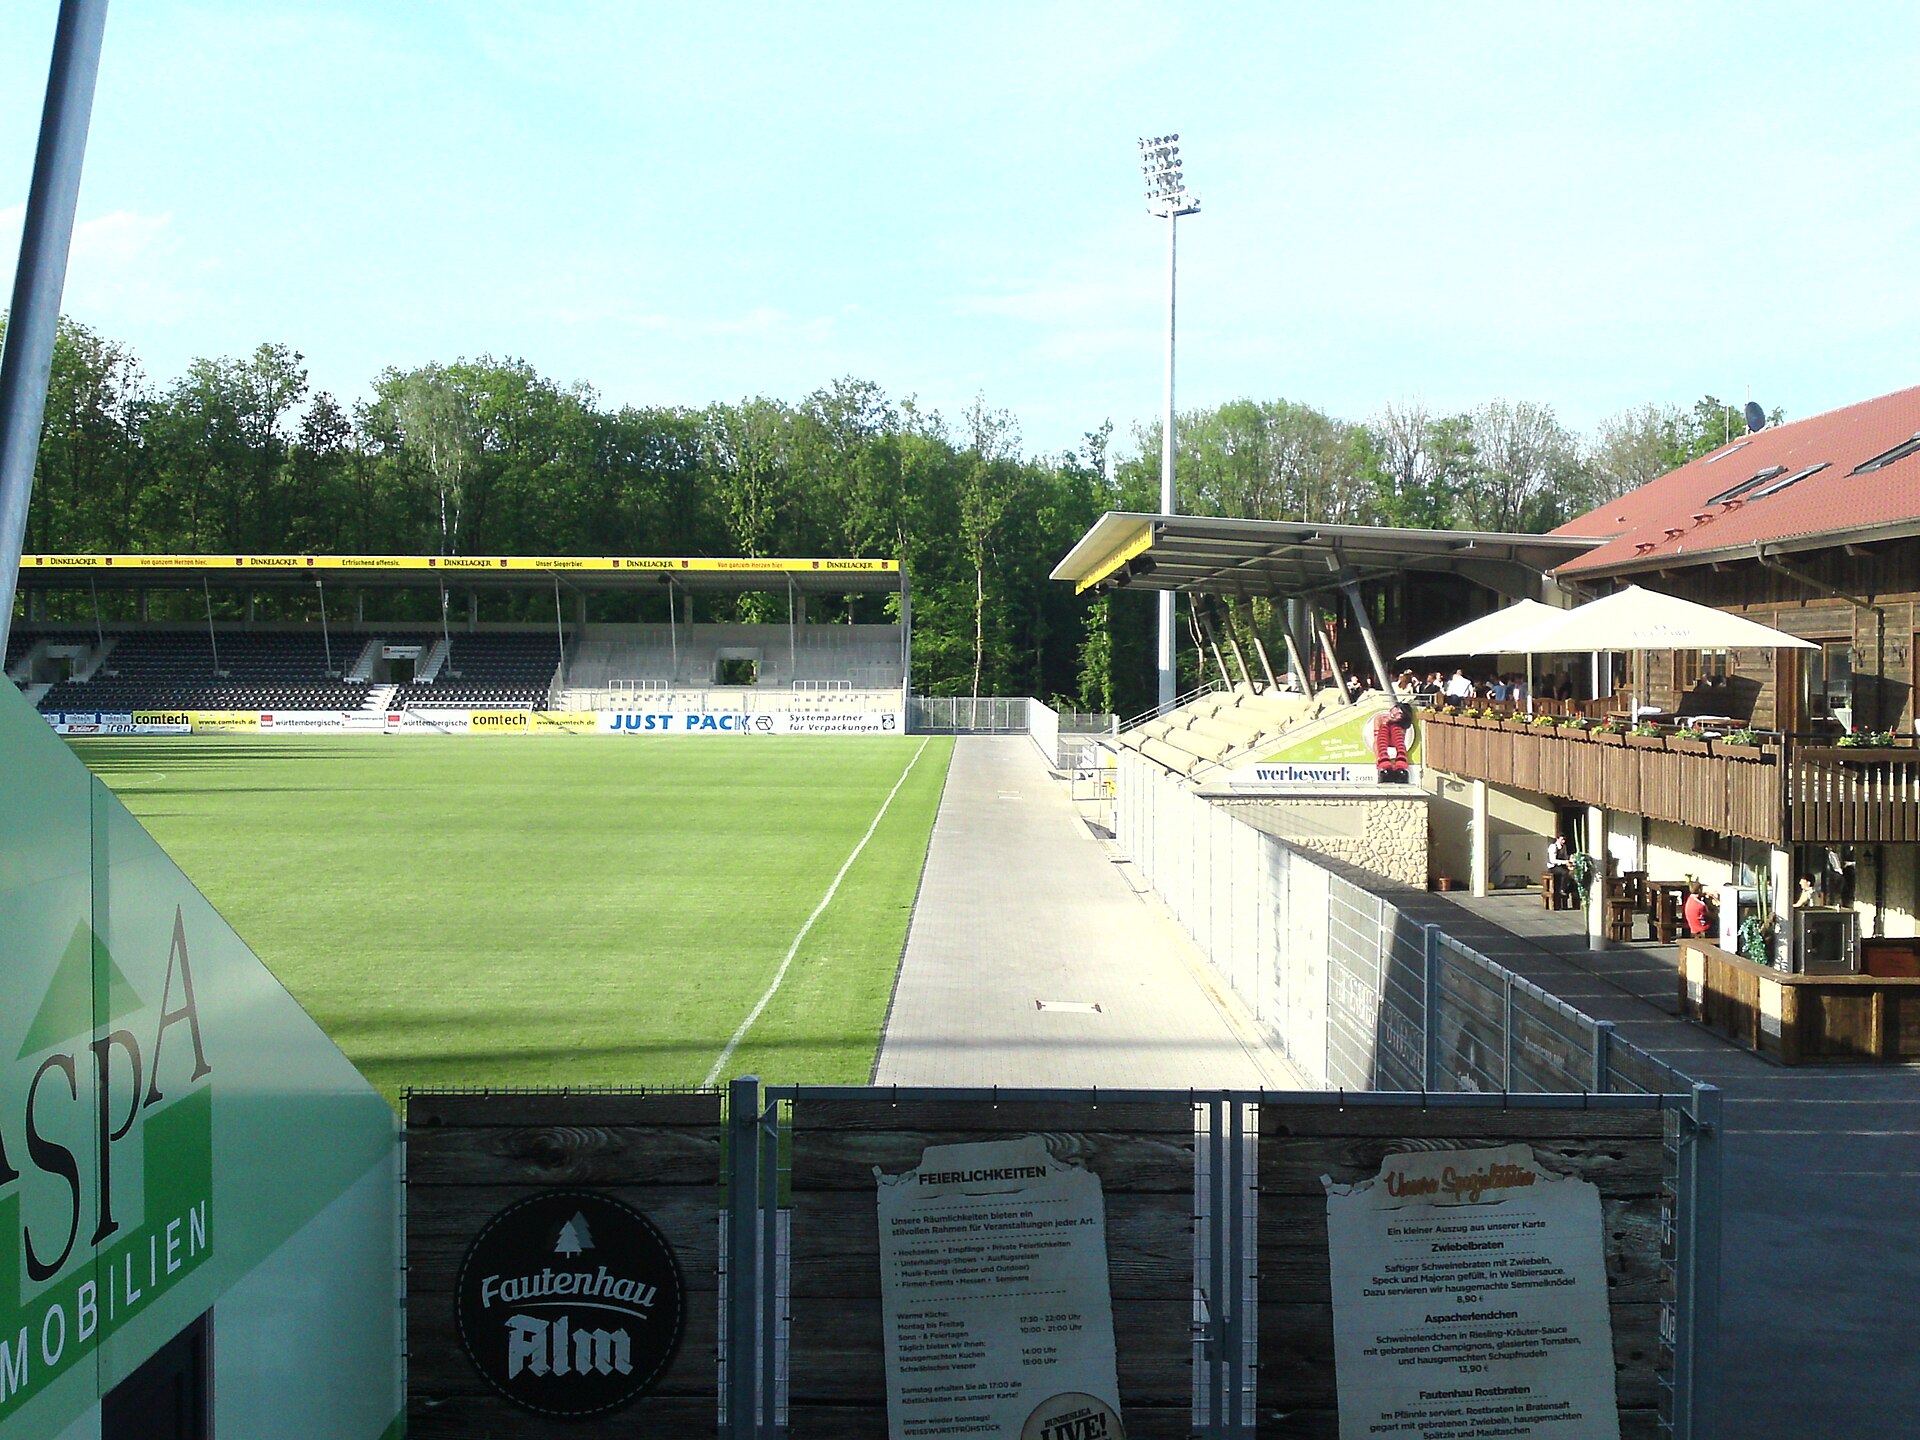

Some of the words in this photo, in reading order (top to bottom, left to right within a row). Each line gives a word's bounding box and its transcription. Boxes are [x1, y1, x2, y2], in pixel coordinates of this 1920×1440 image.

[136, 713, 188, 724] comtech
[275, 717, 341, 727] württembergische
[403, 717, 468, 727] württembergische
[472, 712, 527, 725] comtech
[610, 714, 674, 730] JUST
[686, 715, 751, 731] PACK
[789, 713, 863, 723] Systempartner
[789, 723, 806, 732] für
[809, 723, 879, 733] Verpackungen
[1256, 766, 1351, 782] werbewerk
[918, 1165, 1046, 1186] FEIERLICHKEITEN
[890, 1217, 921, 1226] Unsere
[922, 1213, 989, 1223] Räumlichkeiten
[990, 1211, 1018, 1220] bieten
[1019, 1210, 1033, 1218] ein
[891, 1227, 930, 1236] stilvollen
[931, 1224, 967, 1234] Rahmen
[968, 1222, 982, 1232] für
[982, 1220, 1053, 1231] Veranstaltungen
[1054, 1218, 1077, 1228] jeder
[1387, 1227, 1402, 1236] Ein
[1403, 1226, 1433, 1234] kleiner
[1435, 1225, 1468, 1233] Auszug
[1469, 1224, 1485, 1232] aus
[1486, 1222, 1520, 1231] unserer
[1521, 1220, 1546, 1229] Karte
[1431, 1240, 1504, 1252] Zwiebelbraten
[1384, 1264, 1419, 1273] Saftiger
[1421, 1260, 1491, 1271] Schweinebraten
[1492, 1258, 1508, 1267] mit
[1372, 1275, 1399, 1286] Speck
[1400, 1274, 1419, 1283] und
[1420, 1273, 1455, 1284] Majoran
[1489, 1270, 1498, 1279] in
[481, 1265, 658, 1309] Fautenhau
[1362, 1288, 1386, 1297] Dazu
[1387, 1286, 1428, 1296] servieren
[1429, 1285, 1443, 1293] wir
[1444, 1281, 1509, 1293] hausgemachte
[1510, 1276, 1576, 1289] Semmelknödel
[1456, 1294, 1477, 1304] 8,90
[1424, 1309, 1518, 1324] Aspacherlendchen
[1376, 1332, 1457, 1344] Schweinelendchen
[1458, 1331, 1467, 1339] in
[1468, 1326, 1568, 1339] Riesling-Kräuter-Sauce
[503, 1313, 634, 1380] Alm
[1398, 1356, 1416, 1365] und
[1416, 1353, 1487, 1365] hausgemachten
[1488, 1349, 1548, 1360] Schupfnudeln
[1458, 1364, 1482, 1374] 13,90
[1419, 1388, 1473, 1400] Fautenhau
[1474, 1385, 1530, 1397] Rostbraten
[1380, 1412, 1393, 1420] Im
[1393, 1409, 1427, 1419] Pfännle
[1465, 1405, 1514, 1415] Rostbraten
[1515, 1404, 1524, 1412] in
[1525, 1400, 1570, 1411] Bratensaft
[1369, 1423, 1399, 1433] gegart
[1400, 1421, 1416, 1430] mit
[1417, 1420, 1468, 1431] gebratenen
[1513, 1411, 1582, 1424] hausgemachten
